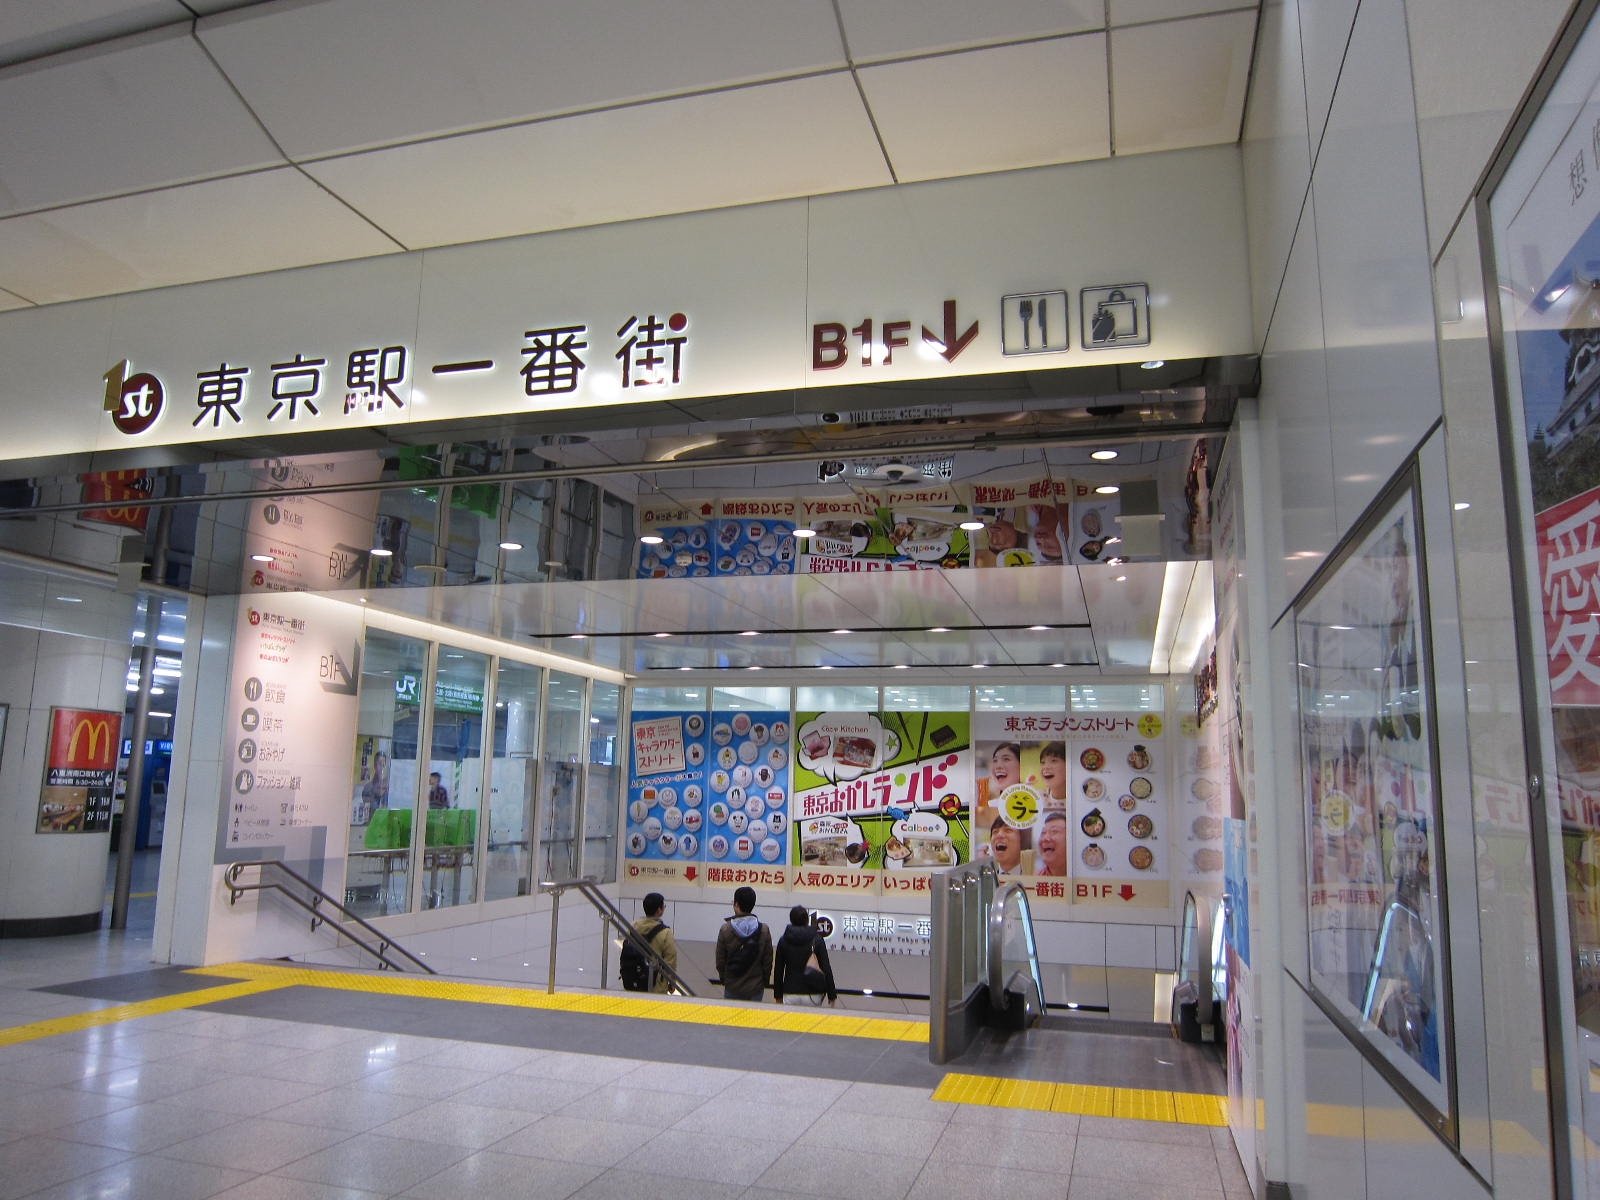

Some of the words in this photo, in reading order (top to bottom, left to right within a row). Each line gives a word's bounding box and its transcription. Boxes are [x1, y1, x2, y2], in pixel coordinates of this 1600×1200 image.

[813, 318, 912, 371] B1F
[192, 313, 688, 427] 東京駅一番街
[103, 359, 165, 435] 1st
[319, 654, 342, 681] B1F
[396, 674, 417, 695] JR
[840, 725, 869, 733] Kitchen
[1004, 716, 1135, 732] 東京ラーメンストリート
[636, 726, 656, 740] 東京
[636, 739, 681, 754] キャラクター
[258, 747, 286, 762] おみやげ
[639, 753, 676, 768] ストリート
[901, 824, 934, 832] Calbee
[708, 867, 785, 885] 階段おりたら
[793, 872, 876, 888] 人気のエリア
[1076, 884, 1113, 898] B1F
[843, 933, 863, 941] First
[866, 934, 892, 943] Avenue
[897, 936, 919, 945] Tokyo
